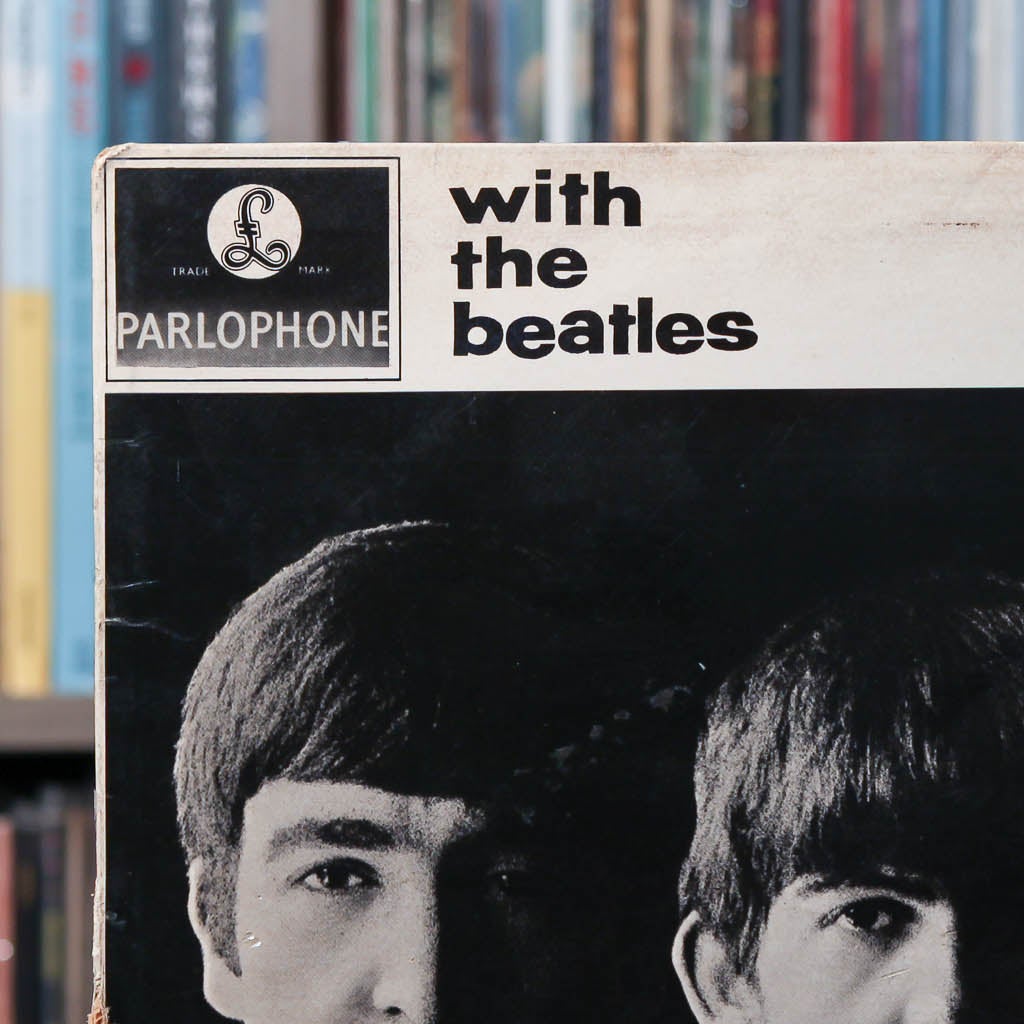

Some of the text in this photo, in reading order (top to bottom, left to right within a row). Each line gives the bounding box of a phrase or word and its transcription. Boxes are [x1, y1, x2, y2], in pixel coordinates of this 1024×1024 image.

[449, 169, 641, 227] with
[172, 266, 209, 277] TRADE
[451, 236, 588, 290] the
[117, 311, 389, 350] PARLOPHONE
[453, 298, 758, 360] beatles
